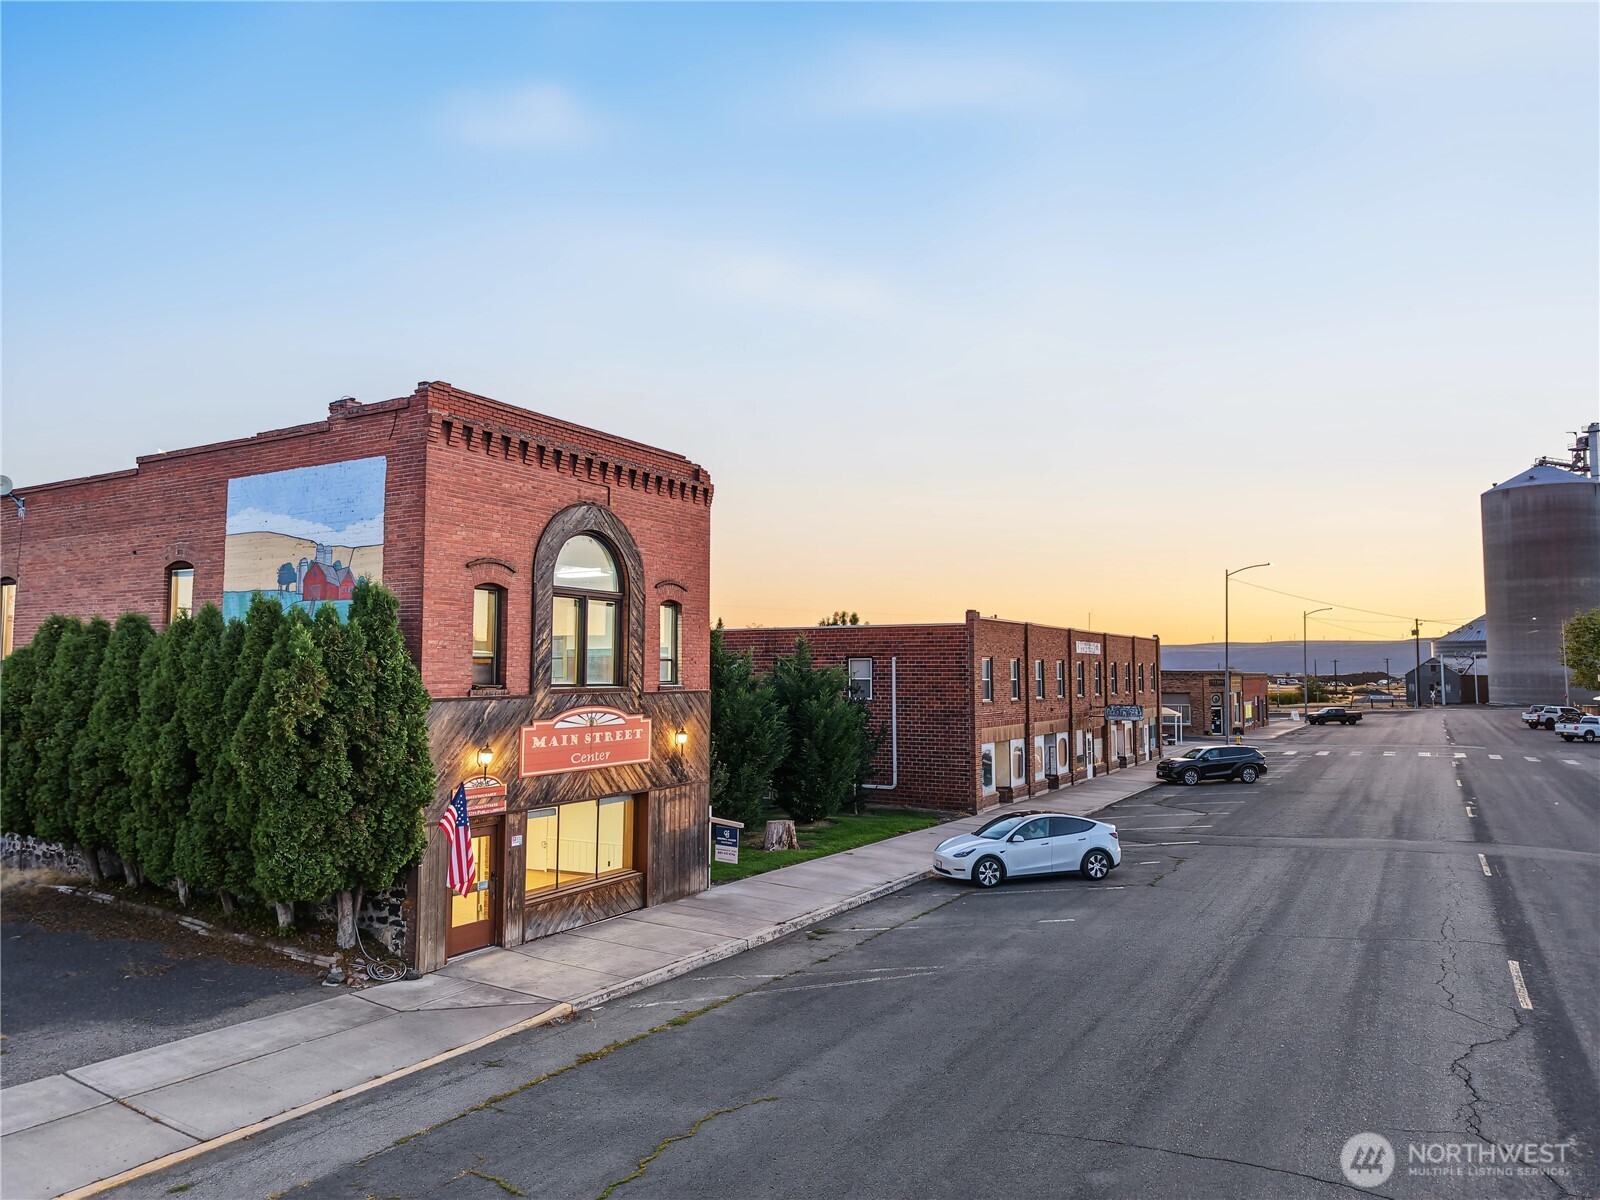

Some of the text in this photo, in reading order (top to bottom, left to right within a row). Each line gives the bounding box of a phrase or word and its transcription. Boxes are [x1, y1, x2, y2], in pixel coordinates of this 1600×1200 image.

[532, 729, 643, 748] MAIN STREET
[571, 751, 611, 763] Center
